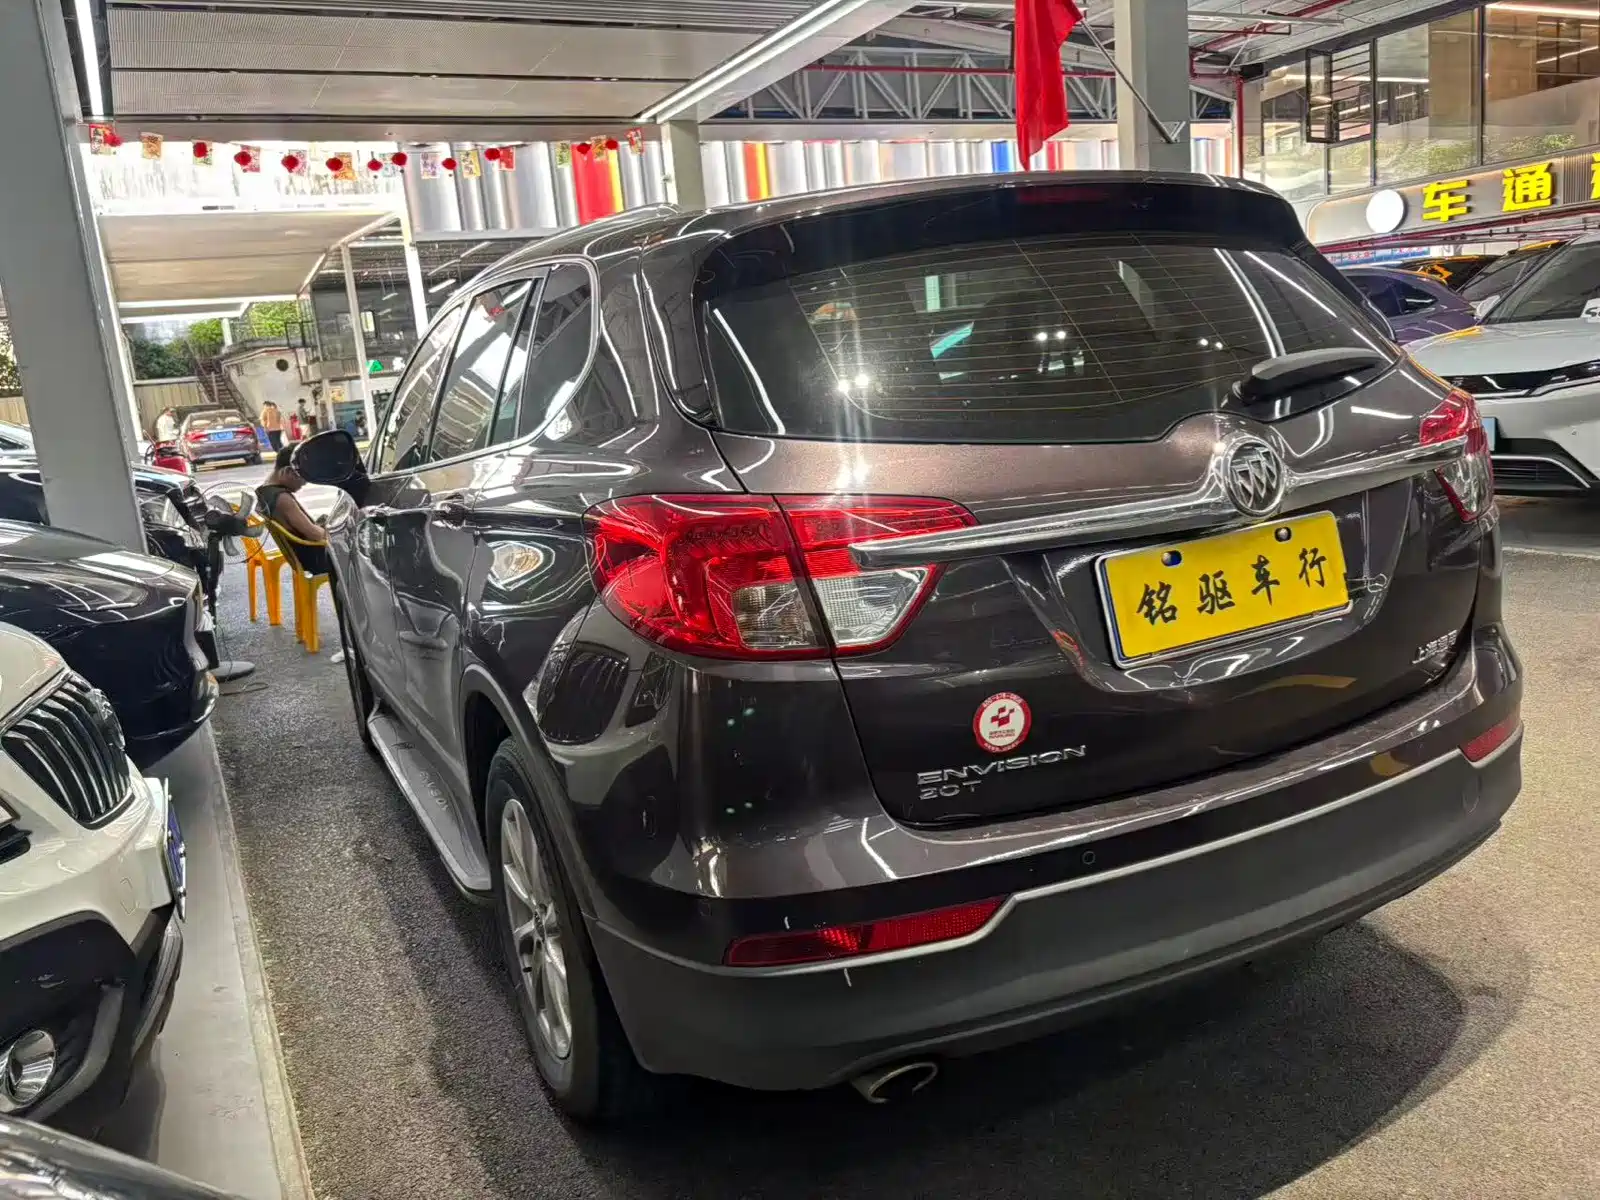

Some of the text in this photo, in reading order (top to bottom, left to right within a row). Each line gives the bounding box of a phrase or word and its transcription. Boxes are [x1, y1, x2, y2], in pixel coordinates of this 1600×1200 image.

[1422, 152, 1600, 222] 车通
[1136, 547, 1327, 625] 铭驱车行
[917, 745, 1086, 784] ENVISION
[920, 780, 982, 800] 20T
